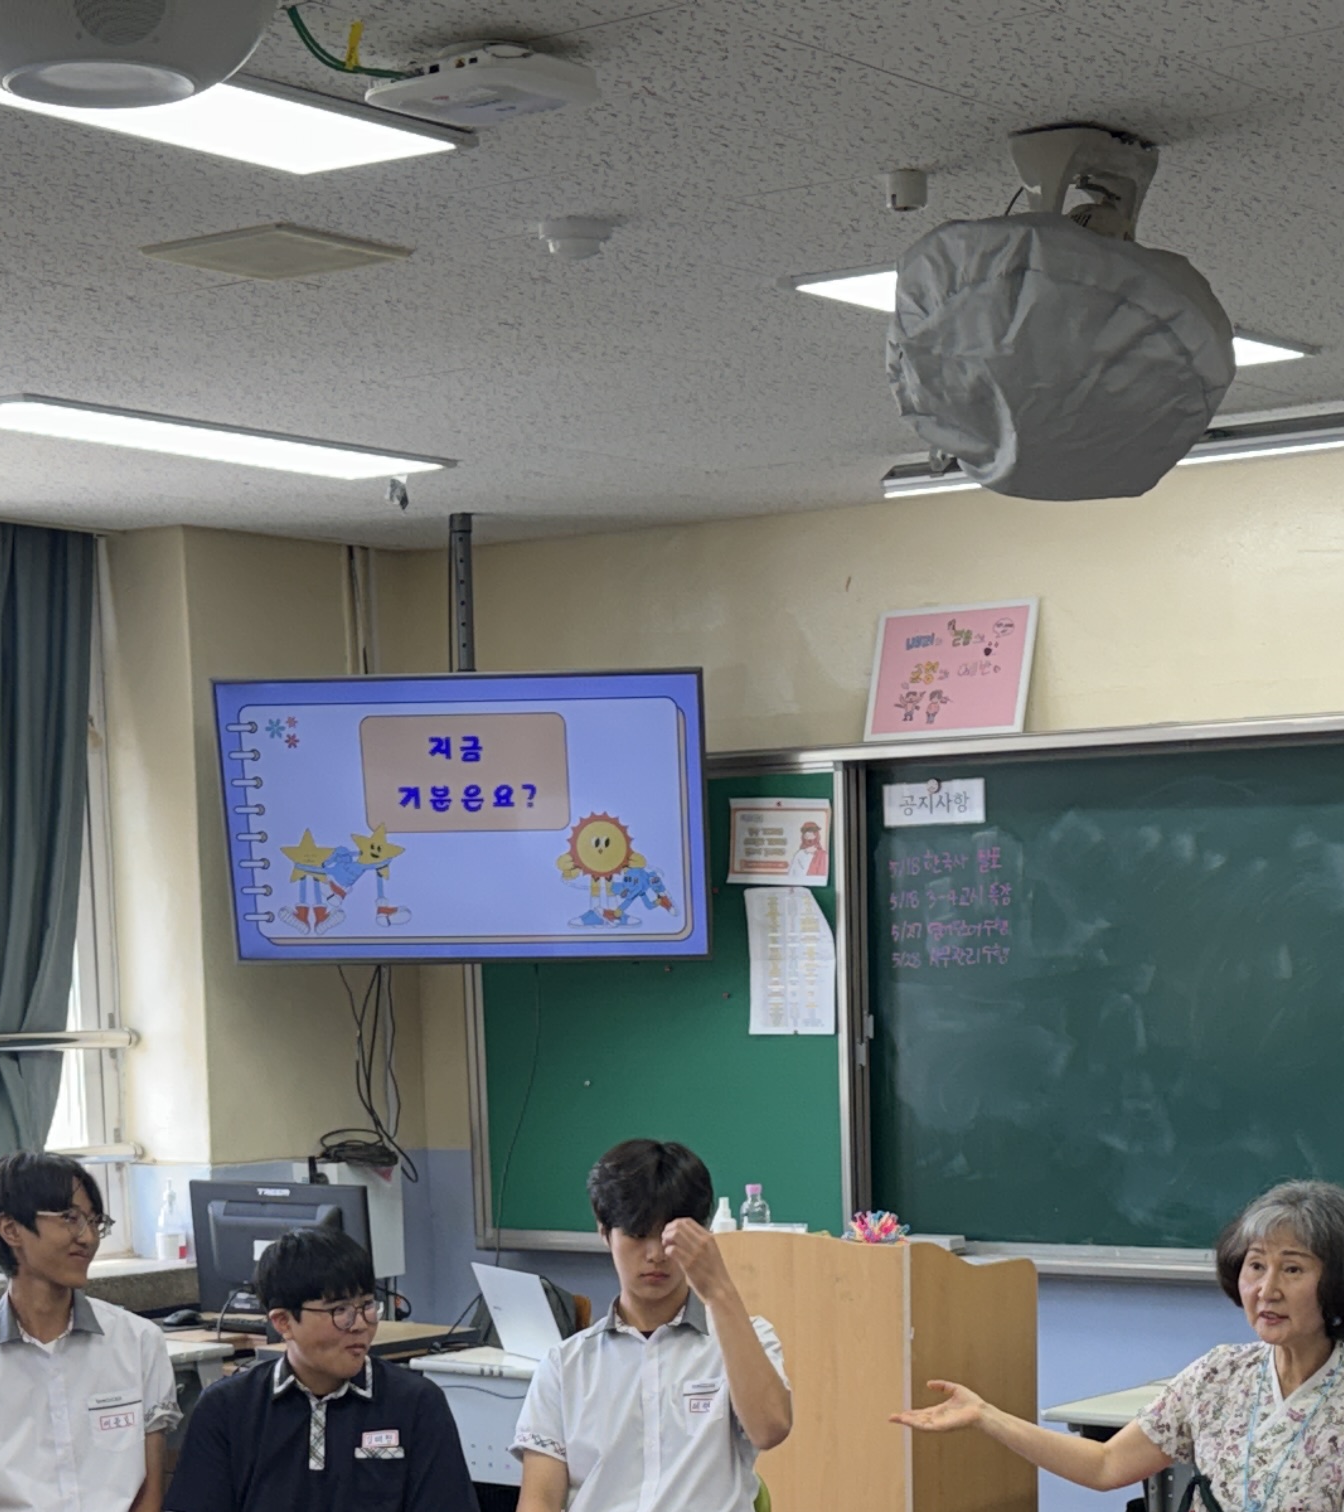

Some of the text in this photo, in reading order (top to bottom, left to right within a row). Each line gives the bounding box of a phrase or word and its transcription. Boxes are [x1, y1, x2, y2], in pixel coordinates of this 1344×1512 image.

[428, 735, 483, 762] 지금
[398, 783, 537, 813] 기분은요?
[899, 791, 971, 816] 공지사항
[922, 848, 969, 874] 한국사
